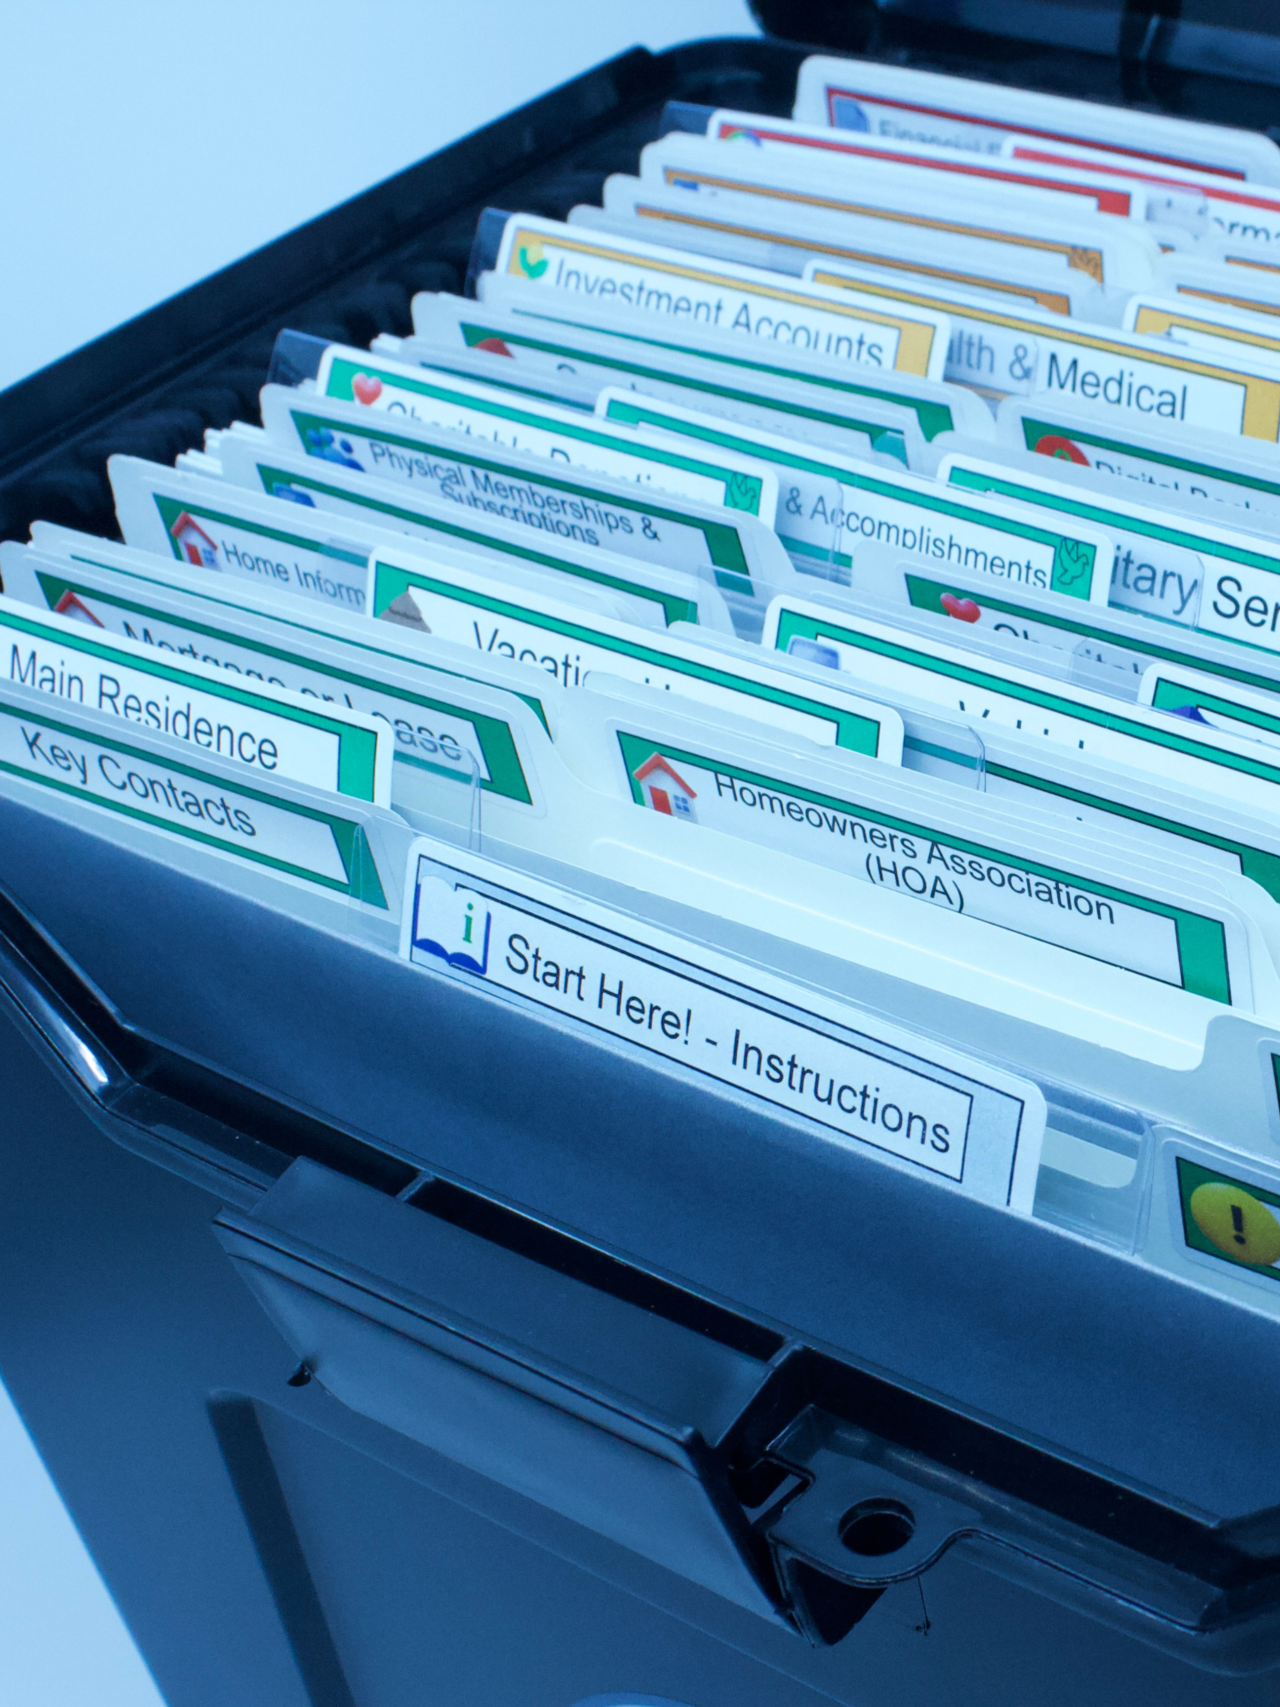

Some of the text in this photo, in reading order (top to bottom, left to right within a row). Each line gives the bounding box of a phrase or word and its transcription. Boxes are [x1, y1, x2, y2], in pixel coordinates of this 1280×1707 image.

[1008, 343, 1033, 382] &
[1047, 352, 1188, 422] Medical
[369, 441, 466, 487] Physical
[468, 468, 634, 535] Memberships
[641, 516, 662, 543] &
[220, 540, 290, 583] Home
[9, 643, 85, 703] Main
[98, 672, 279, 771] Residence
[20, 725, 258, 838] Key Contacts
[713, 771, 1116, 925] Homeowners Association
[864, 852, 965, 914] (HOA)
[505, 933, 588, 1002] Start
[597, 973, 693, 1046] Here!
[731, 1029, 951, 1155] Instructions
